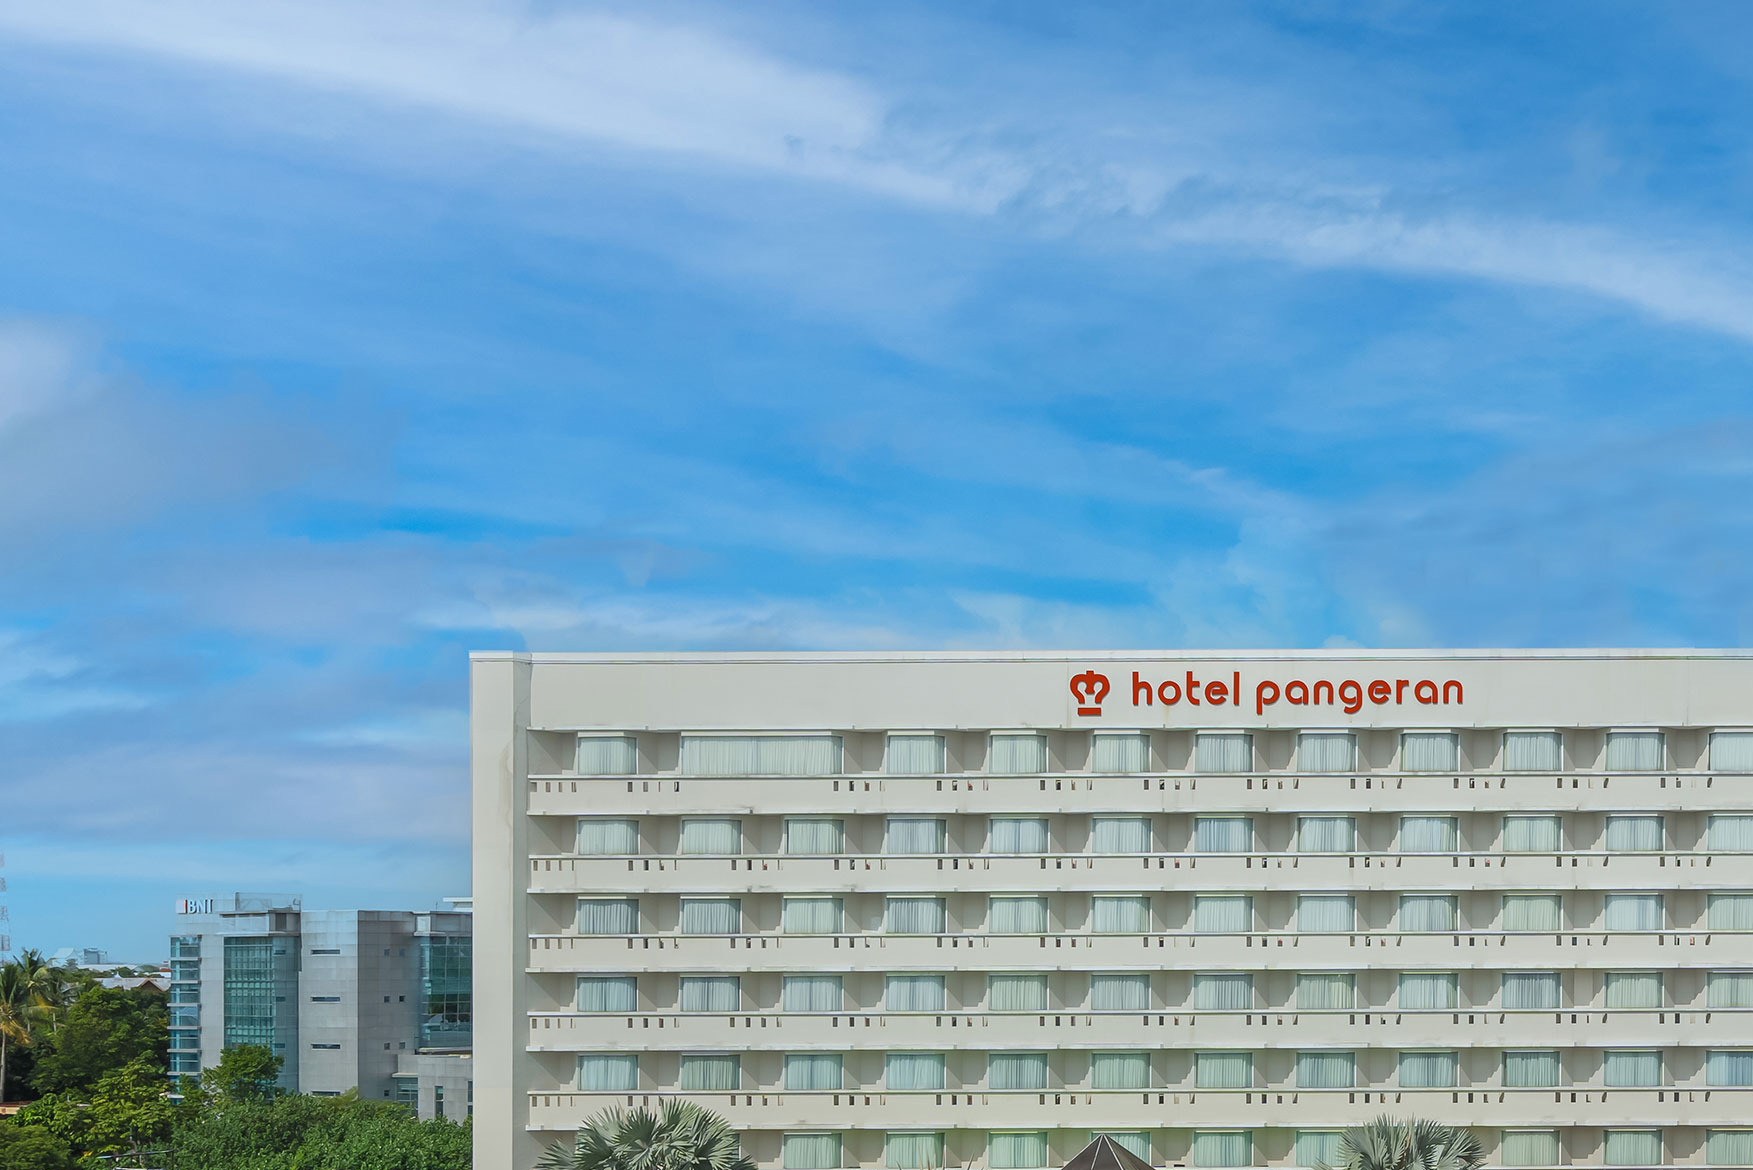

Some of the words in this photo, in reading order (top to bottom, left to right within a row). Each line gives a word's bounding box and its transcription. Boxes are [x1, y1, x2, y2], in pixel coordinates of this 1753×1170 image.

[1132, 671, 1240, 706] hotel
[1256, 679, 1464, 715] pangeran
[187, 898, 214, 914] BNI
